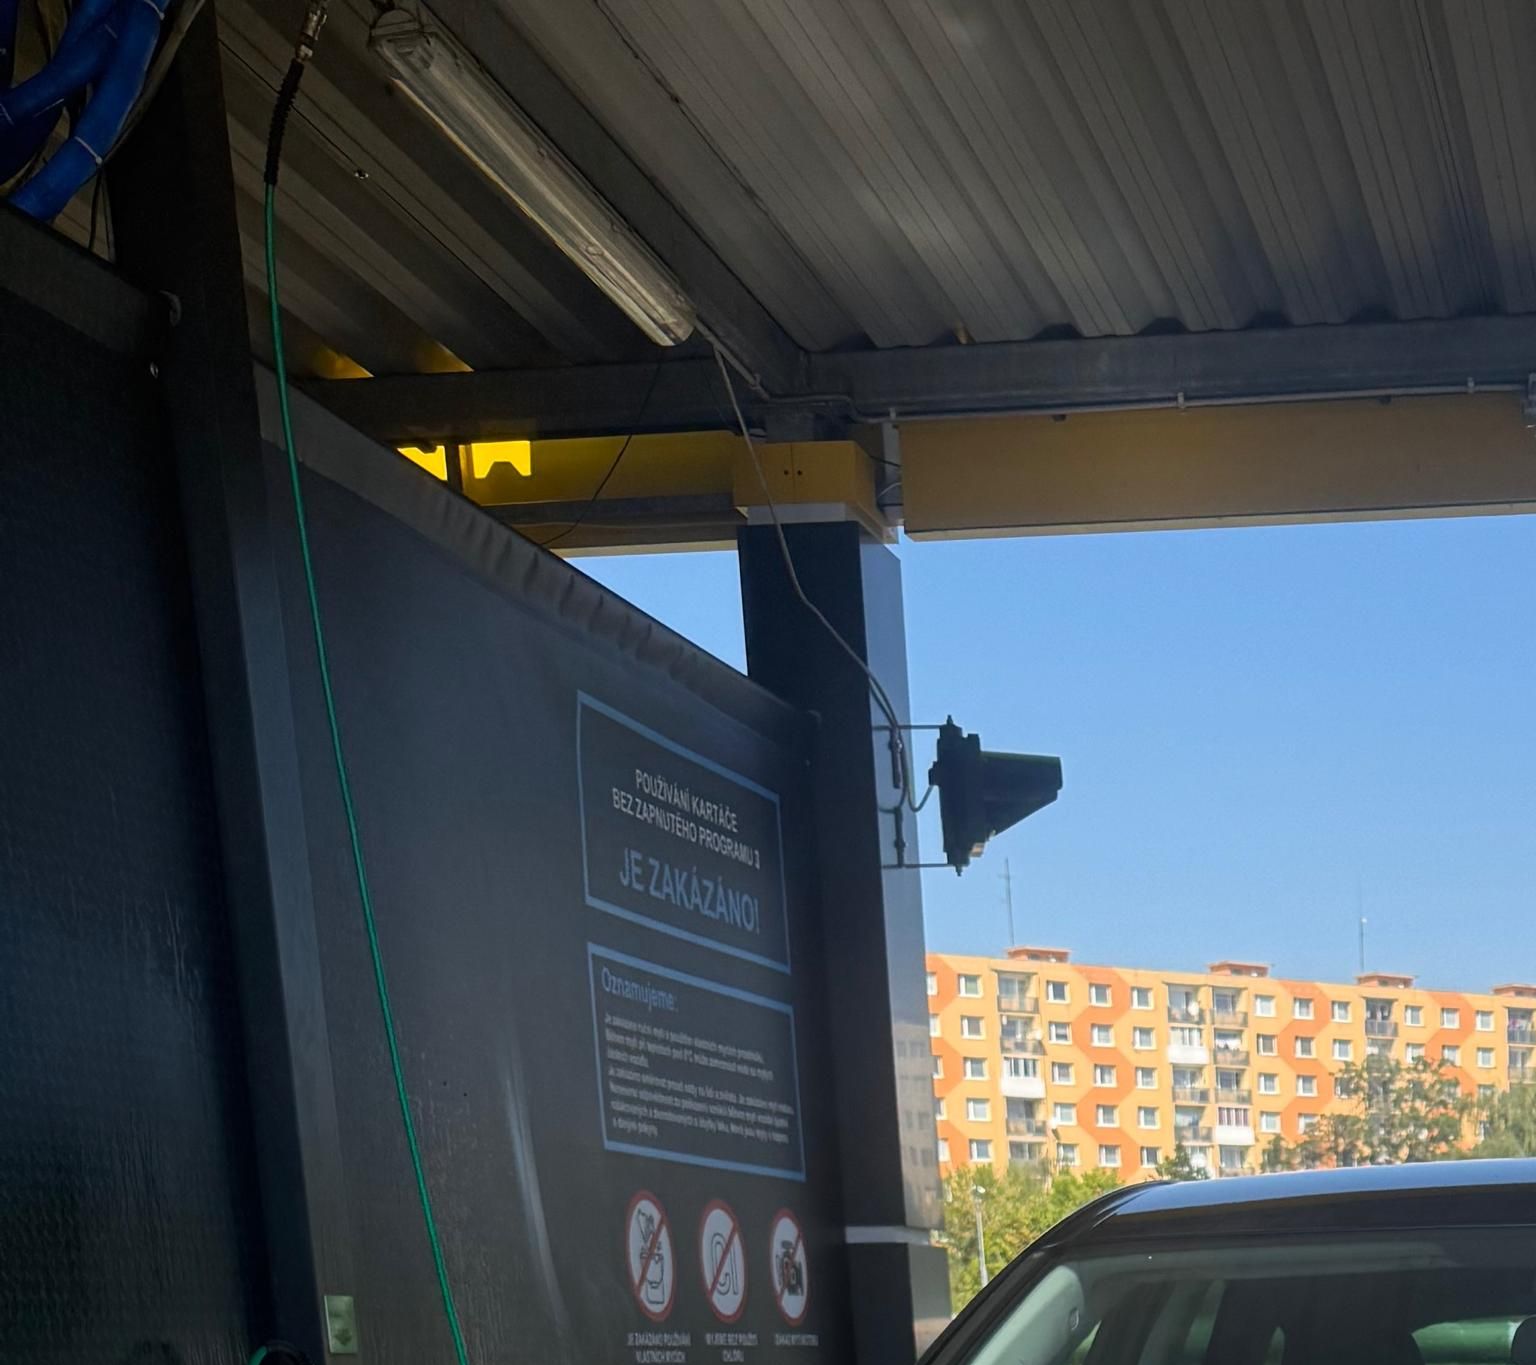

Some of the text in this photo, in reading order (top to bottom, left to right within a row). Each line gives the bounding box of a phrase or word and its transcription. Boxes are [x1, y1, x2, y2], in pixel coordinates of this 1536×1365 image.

[612, 788, 634, 815] BEZ
[635, 798, 697, 843] ZAPNUTÉHO
[699, 826, 753, 866] PROGRAMU
[691, 797, 739, 833] KARTÁČE
[619, 848, 760, 936] JE ZAKÁZÁNO!
